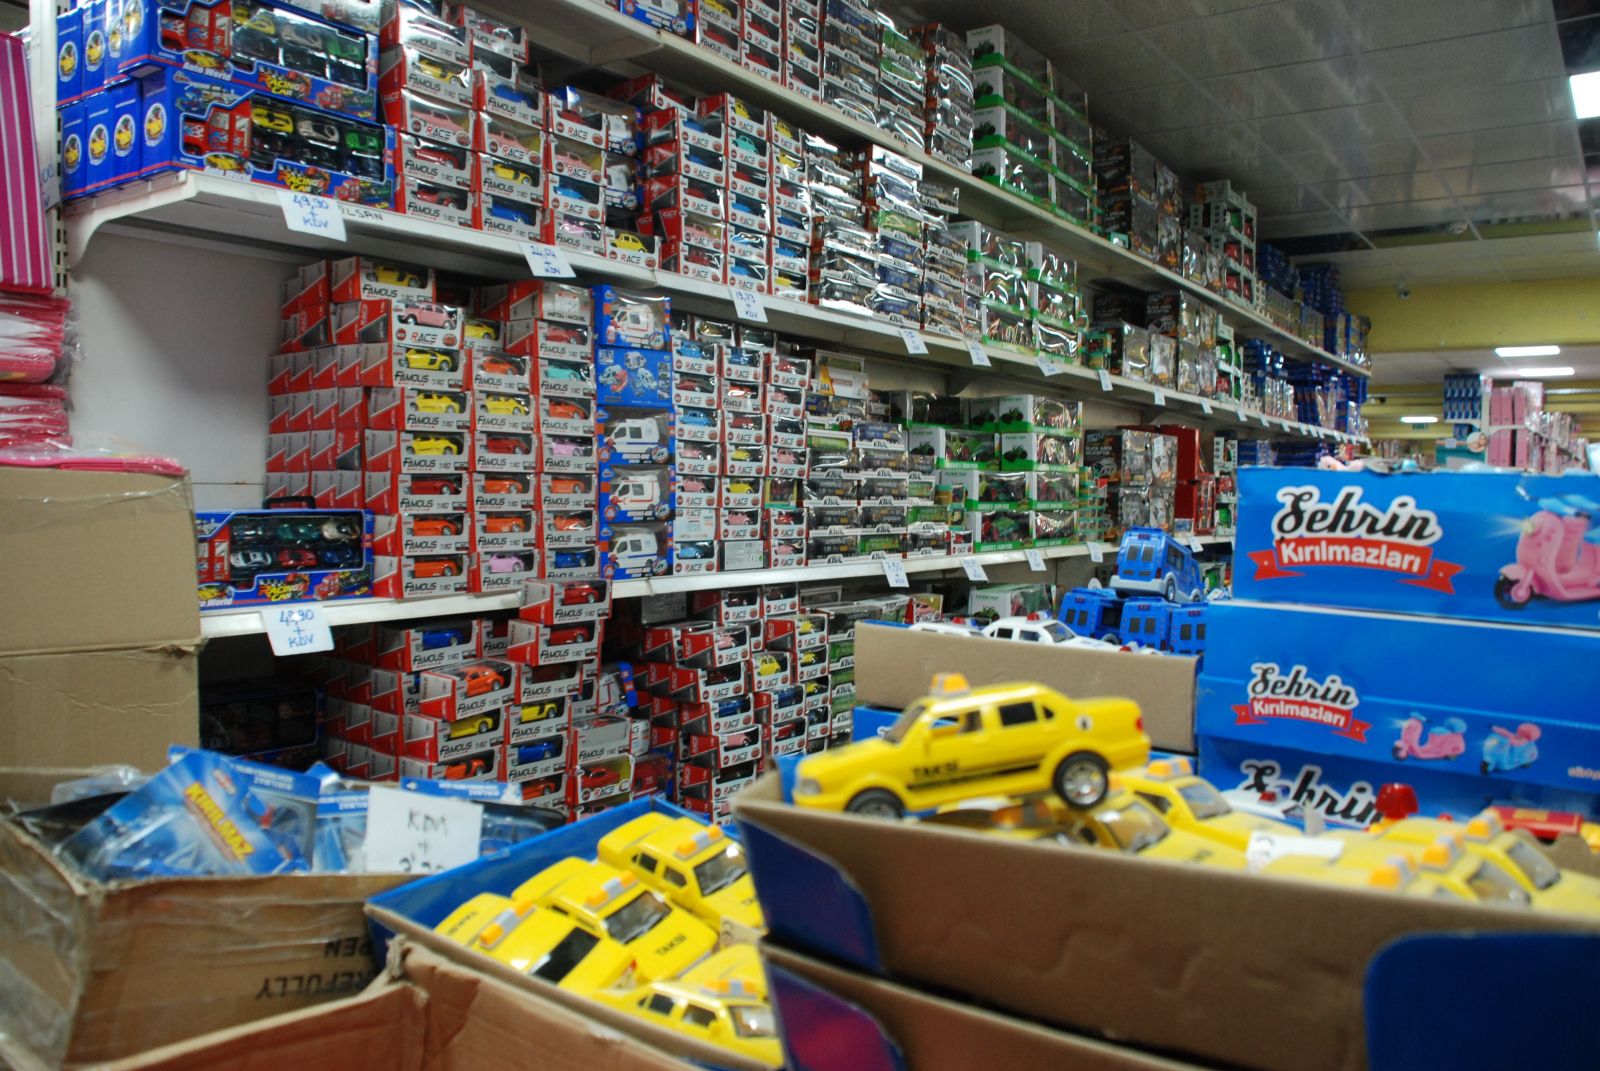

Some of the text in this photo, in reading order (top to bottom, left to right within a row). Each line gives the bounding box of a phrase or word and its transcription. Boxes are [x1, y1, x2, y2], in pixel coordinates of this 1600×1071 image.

[183, 62, 232, 81] Auto World
[409, 74, 440, 92] FAMOUS
[488, 97, 516, 113] FAMOUS
[426, 125, 452, 141] RACE
[568, 127, 588, 139] RACE
[692, 135, 710, 147] RACE
[502, 145, 524, 160] RACE
[405, 160, 438, 176] FAMOUS
[568, 166, 588, 178] RACE
[693, 168, 711, 180] RACE
[483, 178, 514, 193] FAMOUS
[408, 201, 440, 218] FAMOUS
[563, 202, 584, 214] RACE
[692, 202, 709, 212] RACE
[484, 218, 512, 233] FAMOUS
[556, 234, 580, 248] FAMOUS
[620, 254, 641, 264] RACE
[692, 269, 708, 279] RACE
[738, 279, 754, 289] RACE
[362, 284, 397, 298] FAMOUS
[410, 332, 438, 343] RACE
[540, 343, 566, 354] FAMOUS
[685, 362, 701, 370] RACE
[394, 371, 429, 383] FAMOUS
[474, 374, 502, 386] FAMOUS
[541, 381, 568, 392] FAMOUS
[407, 415, 439, 426] FAMOUS
[478, 416, 506, 426] FAMOUS
[542, 420, 568, 430] FAMOUS
[688, 430, 704, 438] RACE
[403, 457, 436, 468] FAMOUS
[478, 456, 506, 466] FAMOUS
[545, 458, 571, 468] FAMOUS
[688, 463, 704, 472] RACE
[400, 499, 433, 508] FAMOUS
[476, 496, 505, 506] FAMOUS
[543, 496, 570, 506] FAMOUS
[686, 497, 702, 505] RACE
[478, 536, 507, 546] FAMOUS
[545, 534, 572, 544] FAMOUS
[404, 540, 437, 550] FAMOUS
[1281, 541, 1422, 573] Kırılmazları
[685, 564, 702, 572] RACE
[482, 576, 511, 586] FAMOUS
[404, 582, 437, 592] FAMOUS
[555, 609, 582, 619] FAMOUS
[732, 610, 747, 619] RACE
[288, 634, 314, 648] KDV
[413, 653, 444, 667] FAMOUS
[541, 650, 570, 660] FAMOUS
[725, 652, 739, 661] RACE
[523, 687, 552, 698] FAMOUS
[712, 688, 730, 698] RACE
[458, 700, 486, 714] FAMOUS
[512, 726, 540, 738] FAMOUS
[440, 742, 472, 754] FAMOUS
[579, 748, 606, 761] FAMOUS
[732, 752, 748, 762] RACE
[508, 766, 538, 778] FAMOUS
[594, 786, 615, 796] RACE
[723, 784, 742, 794] RACE
